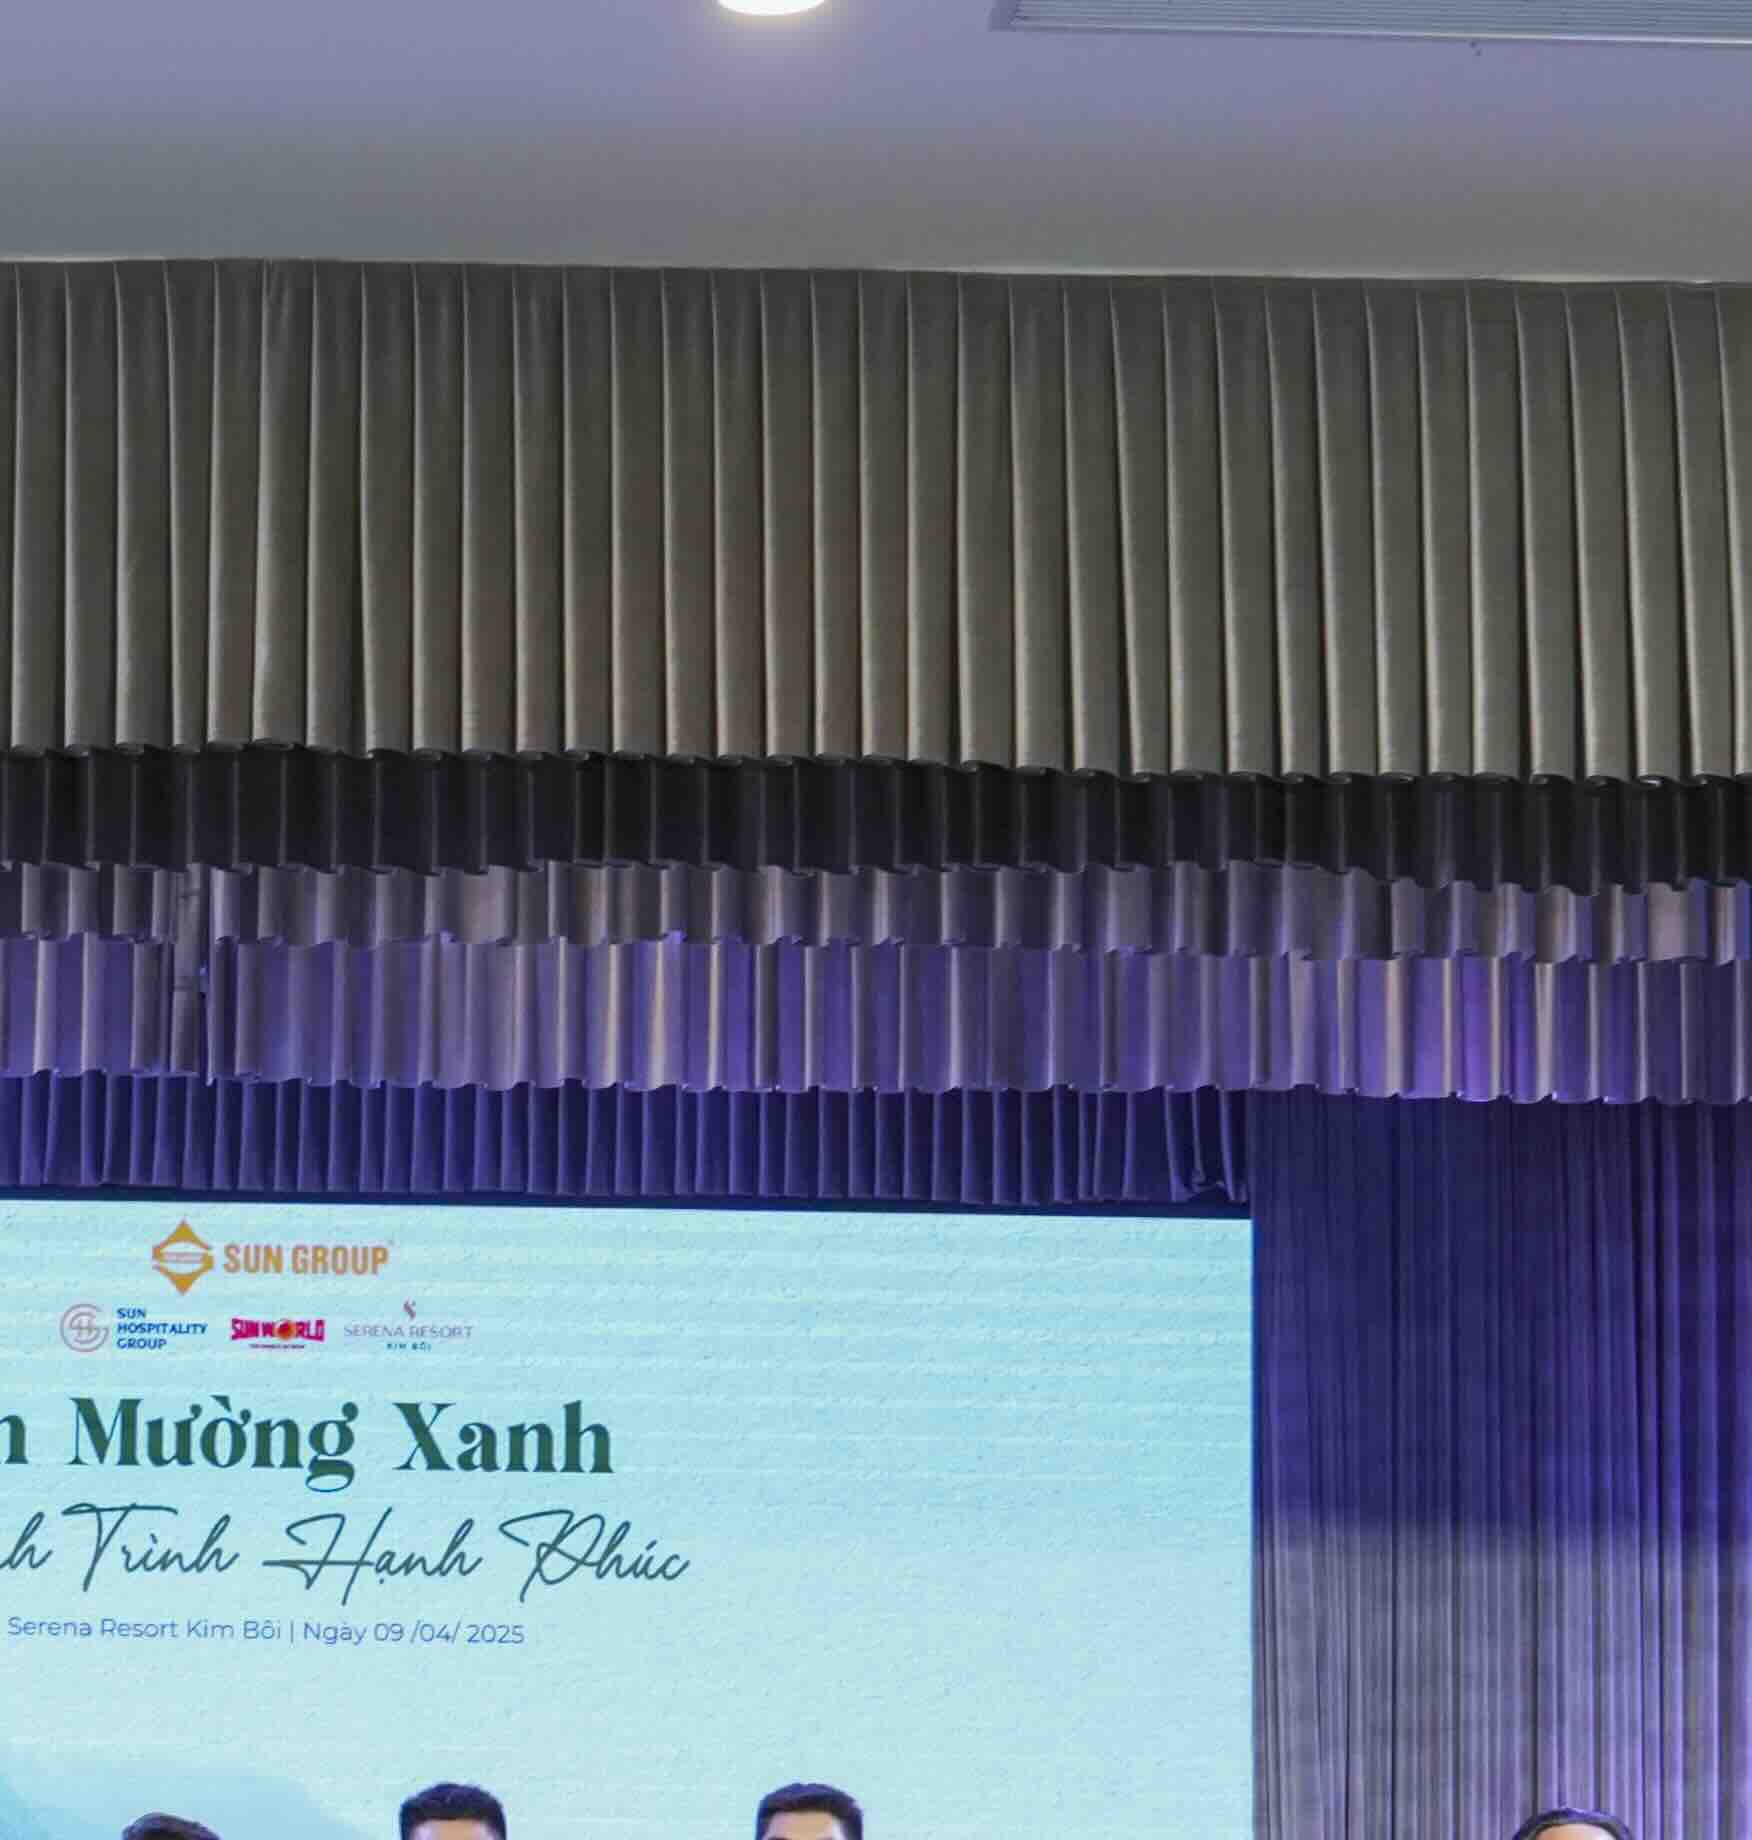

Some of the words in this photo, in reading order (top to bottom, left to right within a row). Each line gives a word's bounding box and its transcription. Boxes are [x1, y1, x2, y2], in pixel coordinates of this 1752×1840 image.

[223, 1244, 283, 1274] SUN
[291, 1244, 390, 1275] GROUP
[116, 1307, 146, 1320] SUN
[116, 1322, 209, 1335] HOSPITALITY
[344, 1325, 405, 1338] SERENA
[407, 1325, 474, 1339] RESORT
[116, 1337, 168, 1350] GROUP
[385, 1342, 408, 1351] KIM
[65, 1395, 359, 1493] Mường
[392, 1400, 615, 1474] Xanh
[61, 1502, 240, 1593] Trình
[262, 1506, 484, 1606] Hạnh
[499, 1509, 691, 1603] Phúc
[7, 1616, 93, 1638] Serena
[100, 1616, 178, 1639] Resort
[185, 1618, 234, 1639] Kim
[242, 1617, 282, 1640] Bôi
[303, 1621, 366, 1645] Ngày
[372, 1622, 405, 1643] 09
[466, 1623, 525, 1644] 2025
